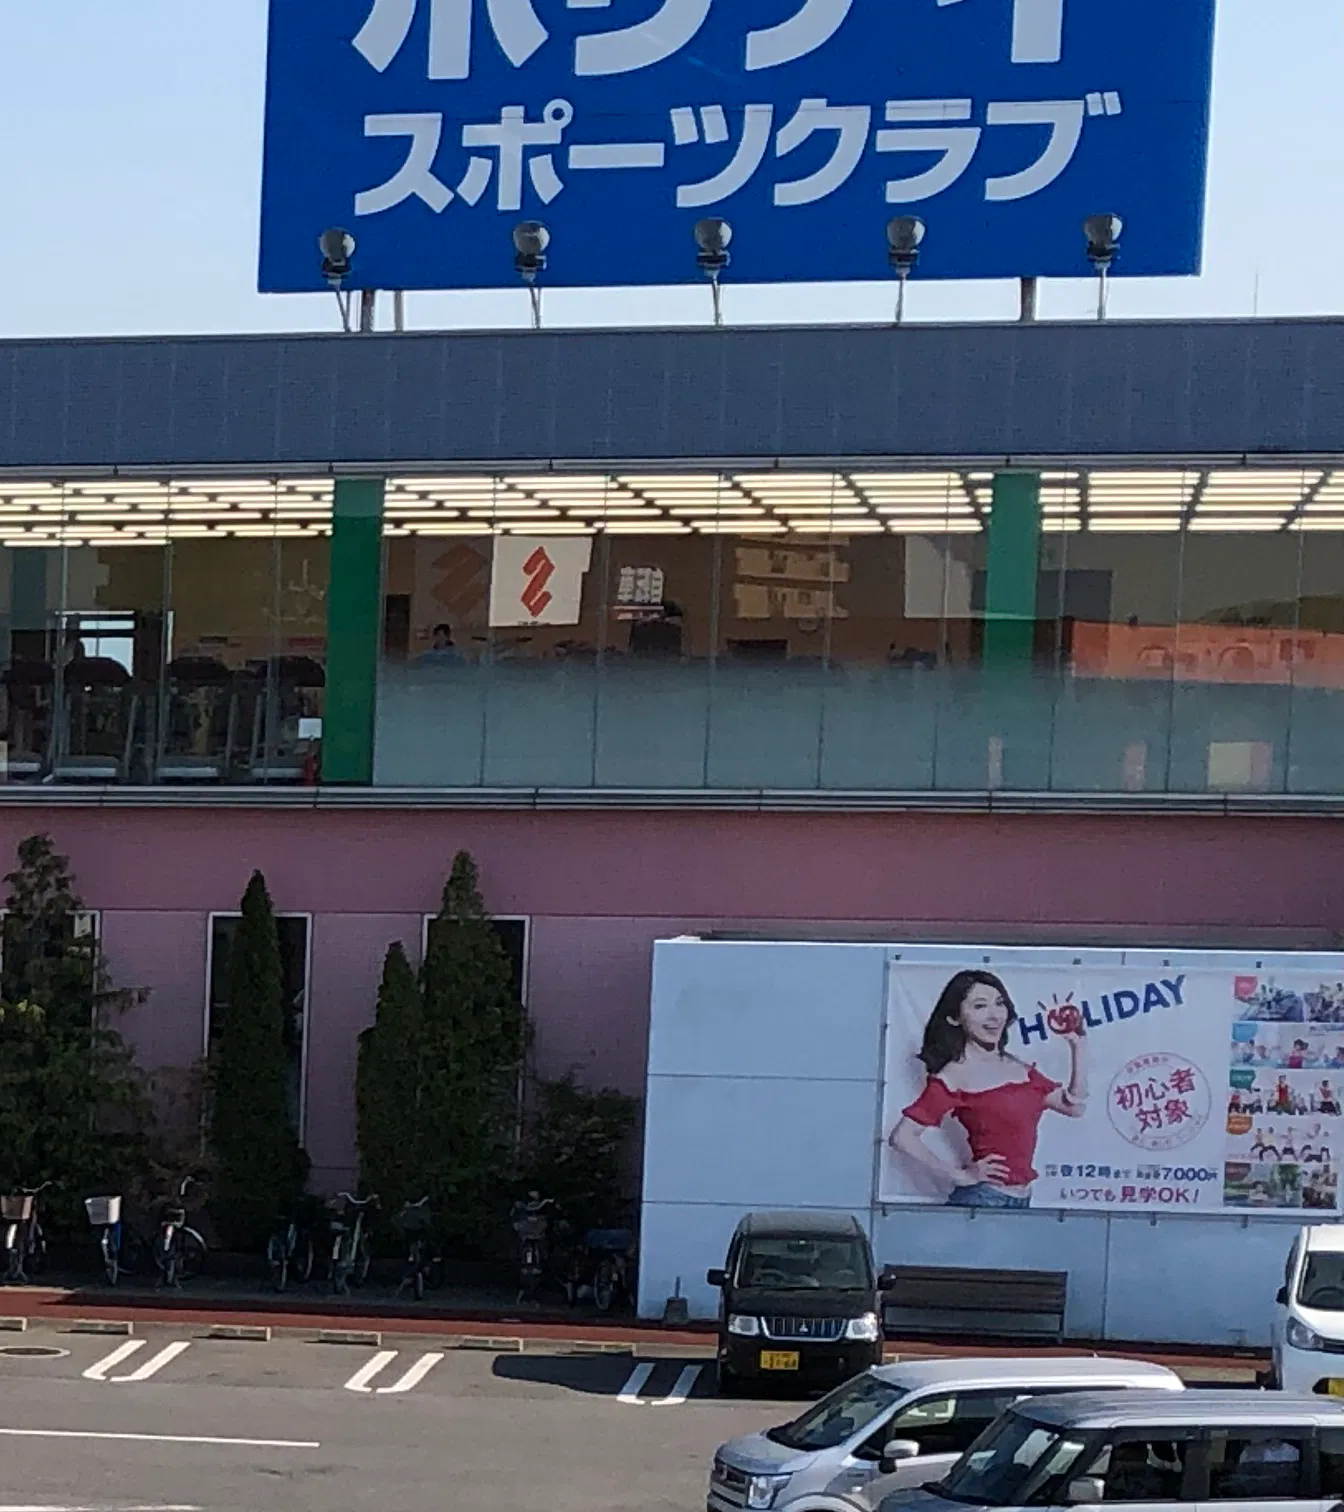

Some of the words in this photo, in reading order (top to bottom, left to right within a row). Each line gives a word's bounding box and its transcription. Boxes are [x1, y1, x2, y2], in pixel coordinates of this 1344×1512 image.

[353, 90, 1121, 215] スポーツクラブ
[1019, 974, 1187, 1045] HOLIDAY
[1114, 1067, 1196, 1110] 初心者
[1135, 1098, 1192, 1133] 対象
